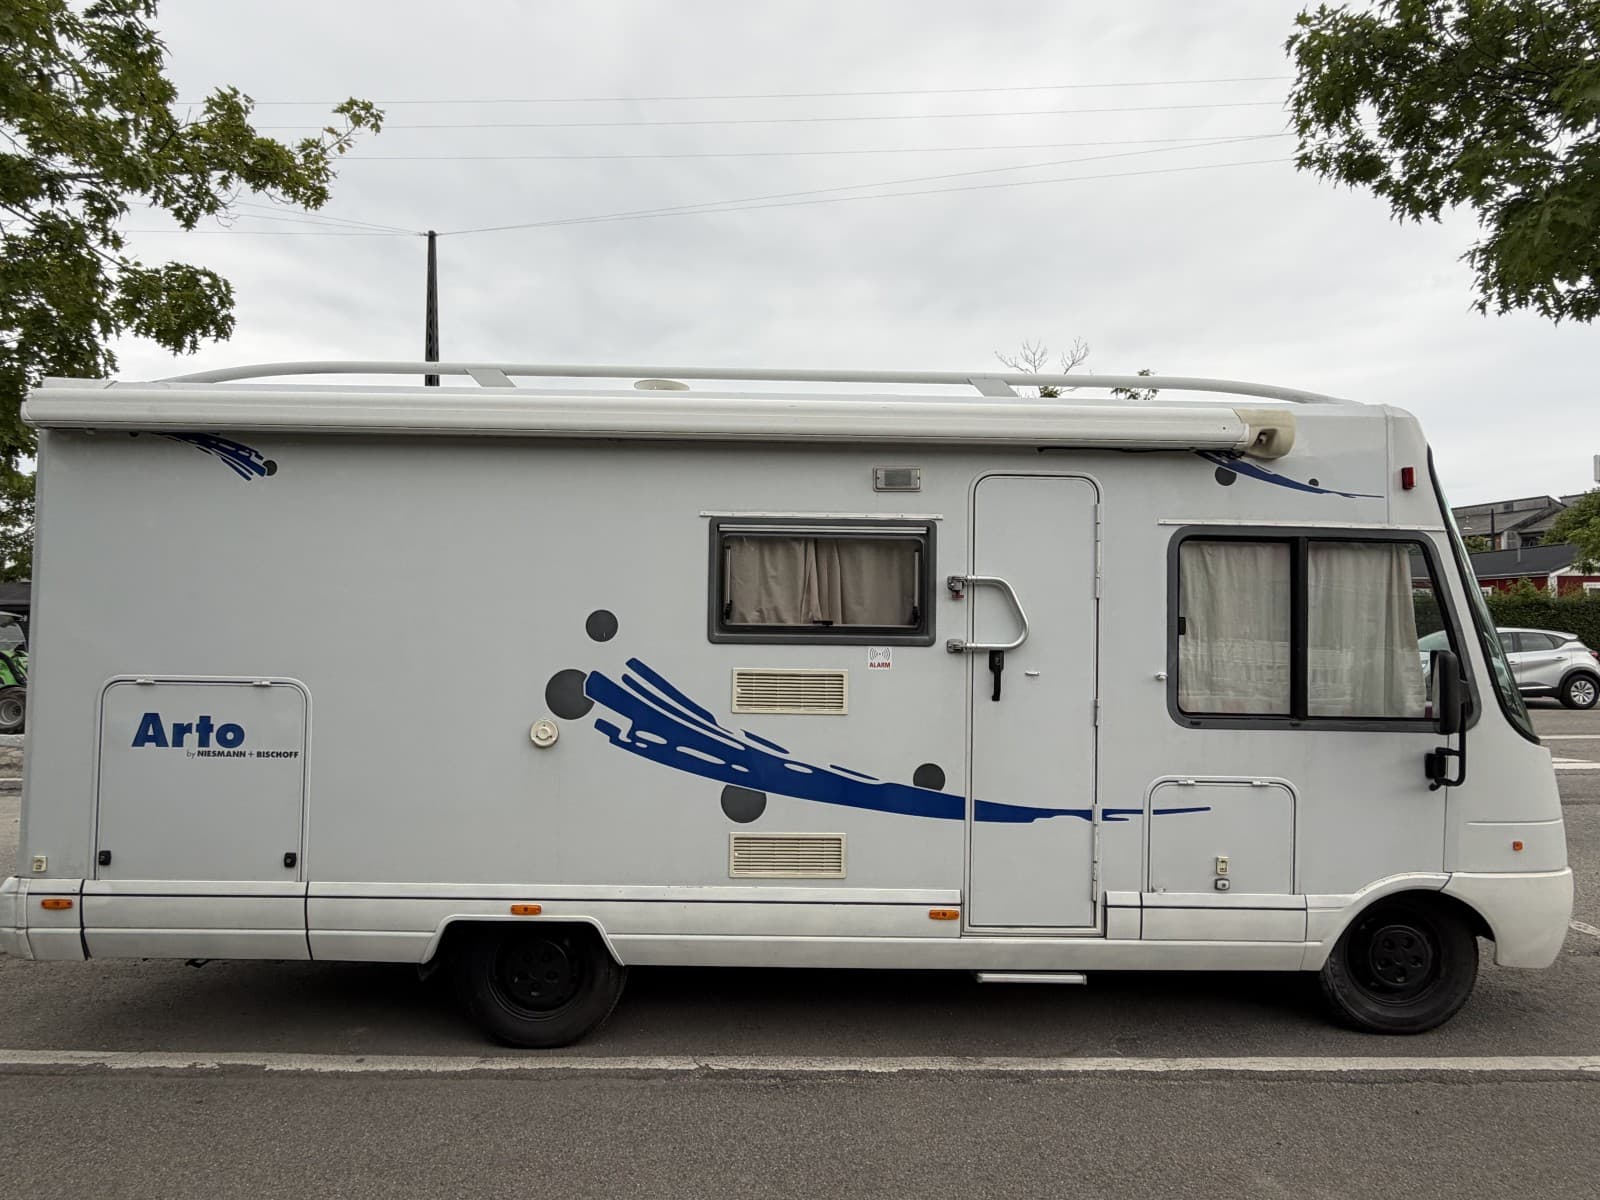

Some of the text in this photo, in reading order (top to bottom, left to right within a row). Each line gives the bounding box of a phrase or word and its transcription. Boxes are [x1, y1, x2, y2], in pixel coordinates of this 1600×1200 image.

[131, 712, 246, 749] Arto
[186, 750, 196, 759] by
[197, 750, 246, 758] NIESMANN
[256, 751, 299, 759] BISCHOFF
